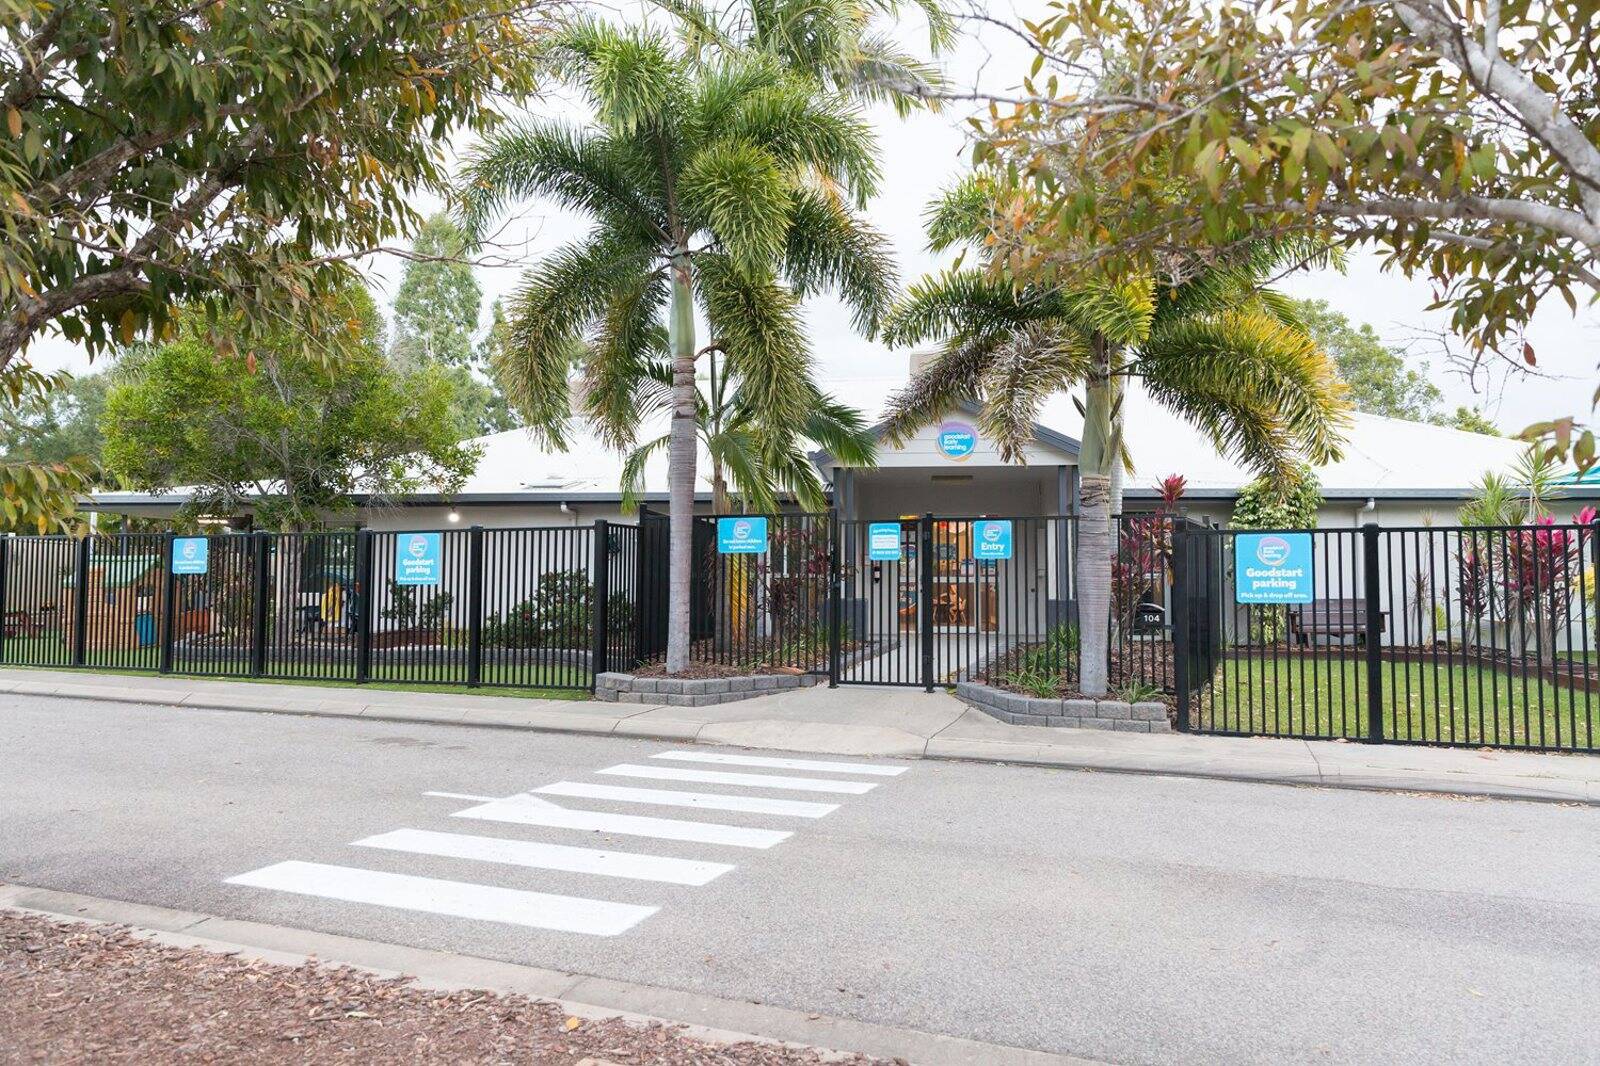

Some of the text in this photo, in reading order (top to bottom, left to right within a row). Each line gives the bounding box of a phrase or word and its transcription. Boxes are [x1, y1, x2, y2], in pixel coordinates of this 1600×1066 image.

[981, 542, 1005, 552] Entry
[1246, 567, 1303, 578] Goodstart
[1252, 578, 1297, 590] parking
[1144, 614, 1160, 622] 104
